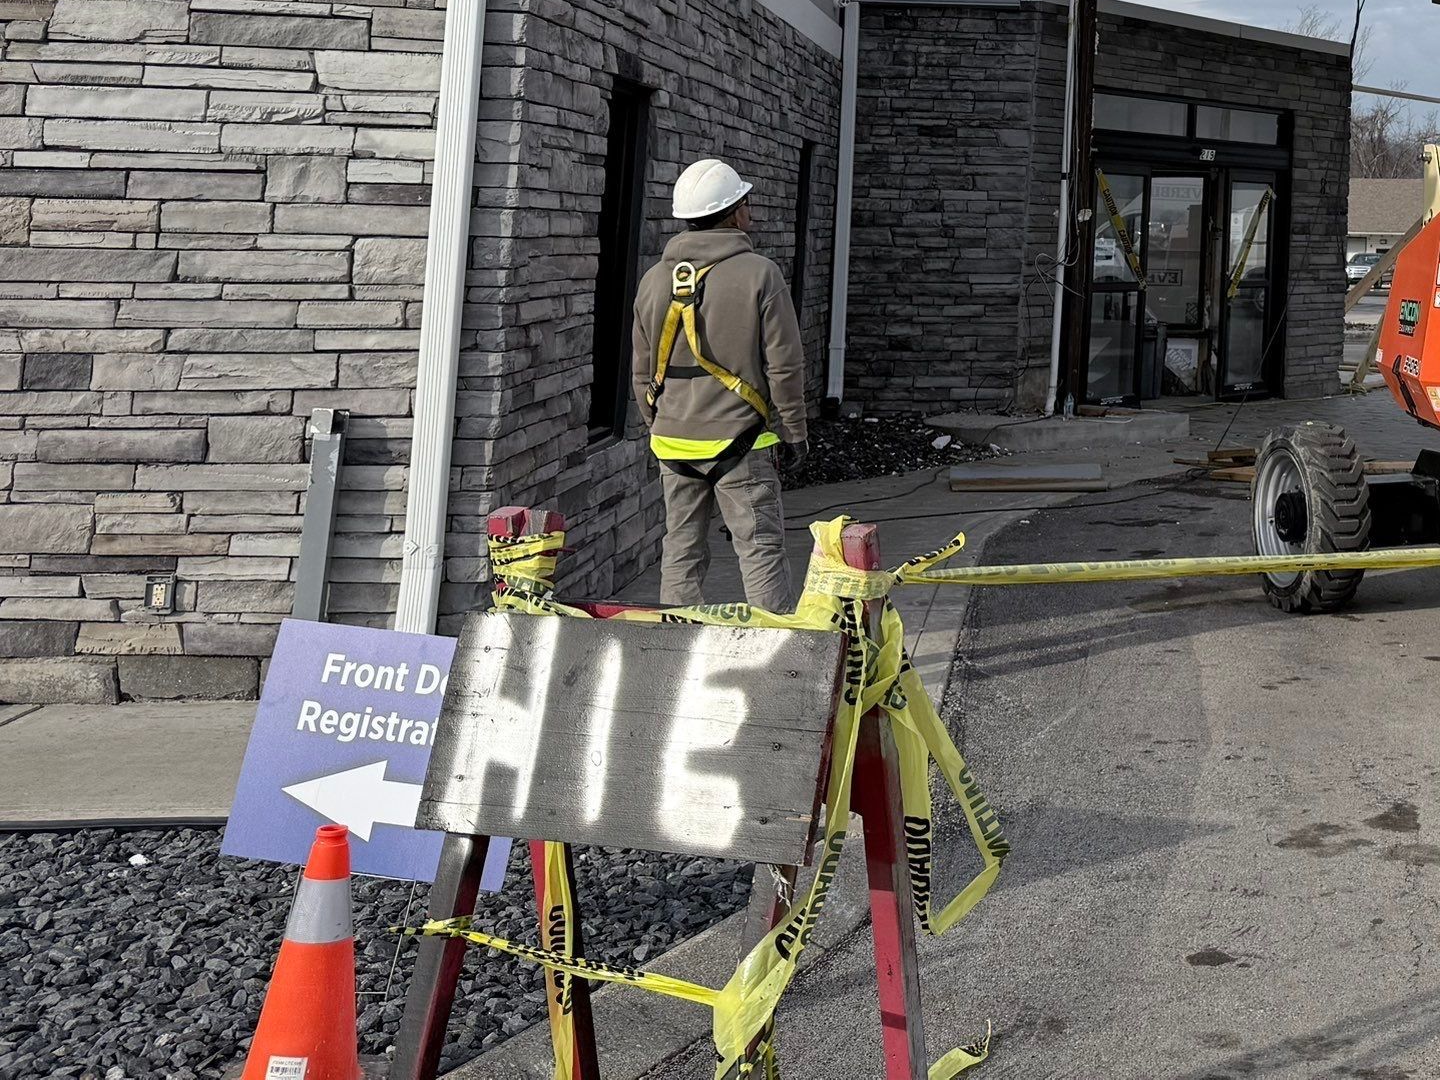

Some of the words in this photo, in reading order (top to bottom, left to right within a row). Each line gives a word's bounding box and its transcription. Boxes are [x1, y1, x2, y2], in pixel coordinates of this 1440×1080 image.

[1103, 188, 1118, 216] CAUTION
[321, 652, 409, 692] Front
[438, 610, 793, 851] HIE
